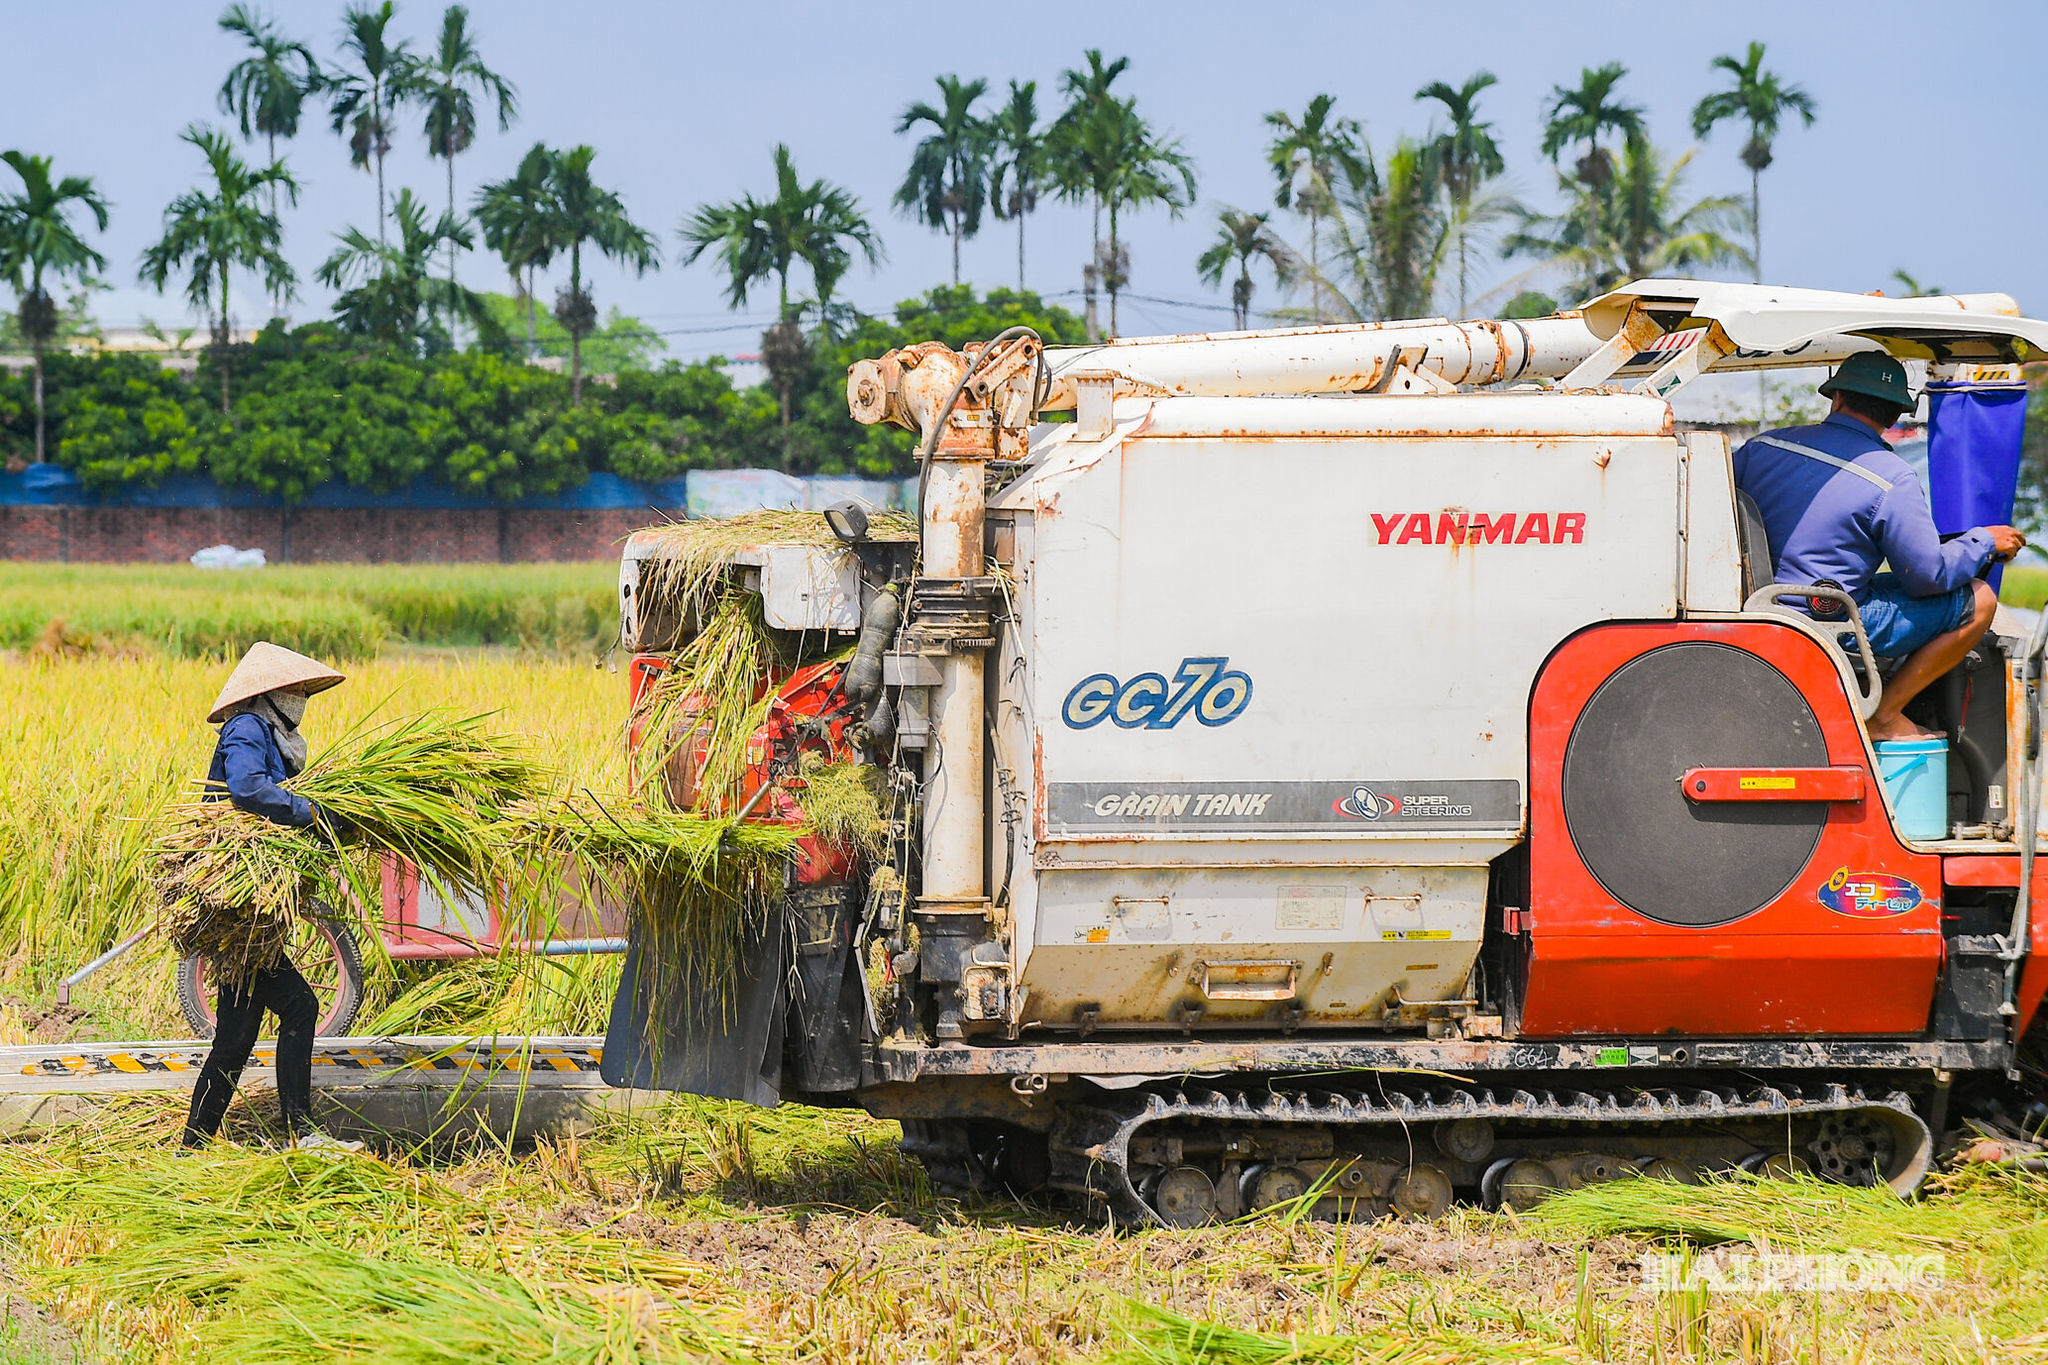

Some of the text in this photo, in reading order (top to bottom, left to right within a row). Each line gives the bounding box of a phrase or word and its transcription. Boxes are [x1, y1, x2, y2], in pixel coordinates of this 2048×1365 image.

[1370, 513, 1586, 545] YANMAR
[1064, 659, 1251, 727] GC70
[1094, 794, 1272, 817] GRAIN TANK
[1402, 795, 1449, 805] SUPER
[1401, 804, 1472, 816] STEERING
[1844, 883, 1875, 897] エコ
